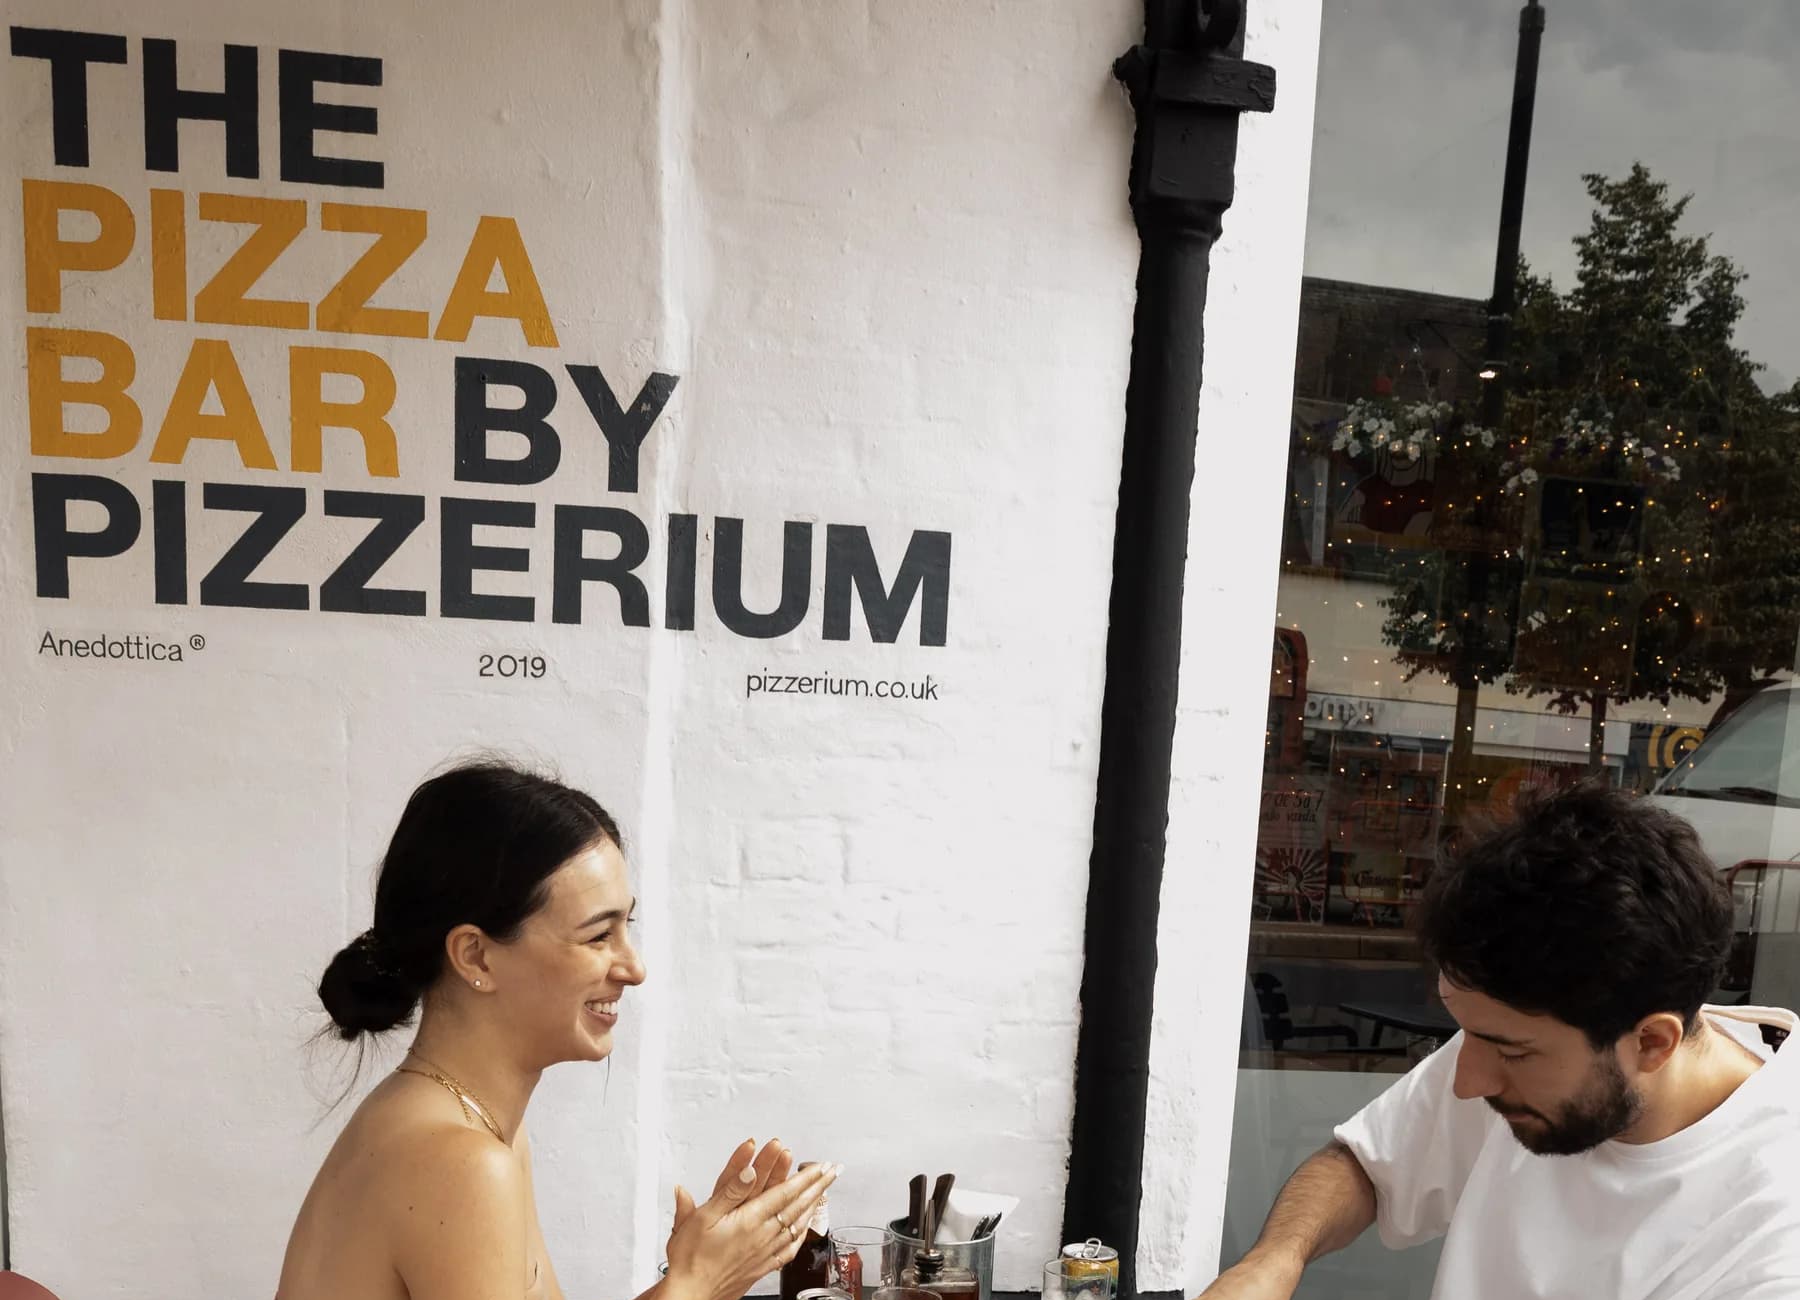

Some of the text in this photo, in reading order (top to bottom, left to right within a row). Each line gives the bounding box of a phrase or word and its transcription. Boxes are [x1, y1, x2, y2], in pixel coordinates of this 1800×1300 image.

[10, 26, 385, 190] THE
[21, 178, 560, 349] PIZZA
[26, 326, 680, 494] BAR BY
[31, 472, 952, 647] PIZZERIUM
[38, 631, 184, 662] Anedottica
[479, 654, 546, 679] 2019
[746, 666, 939, 701] pizzerium.co.uk
